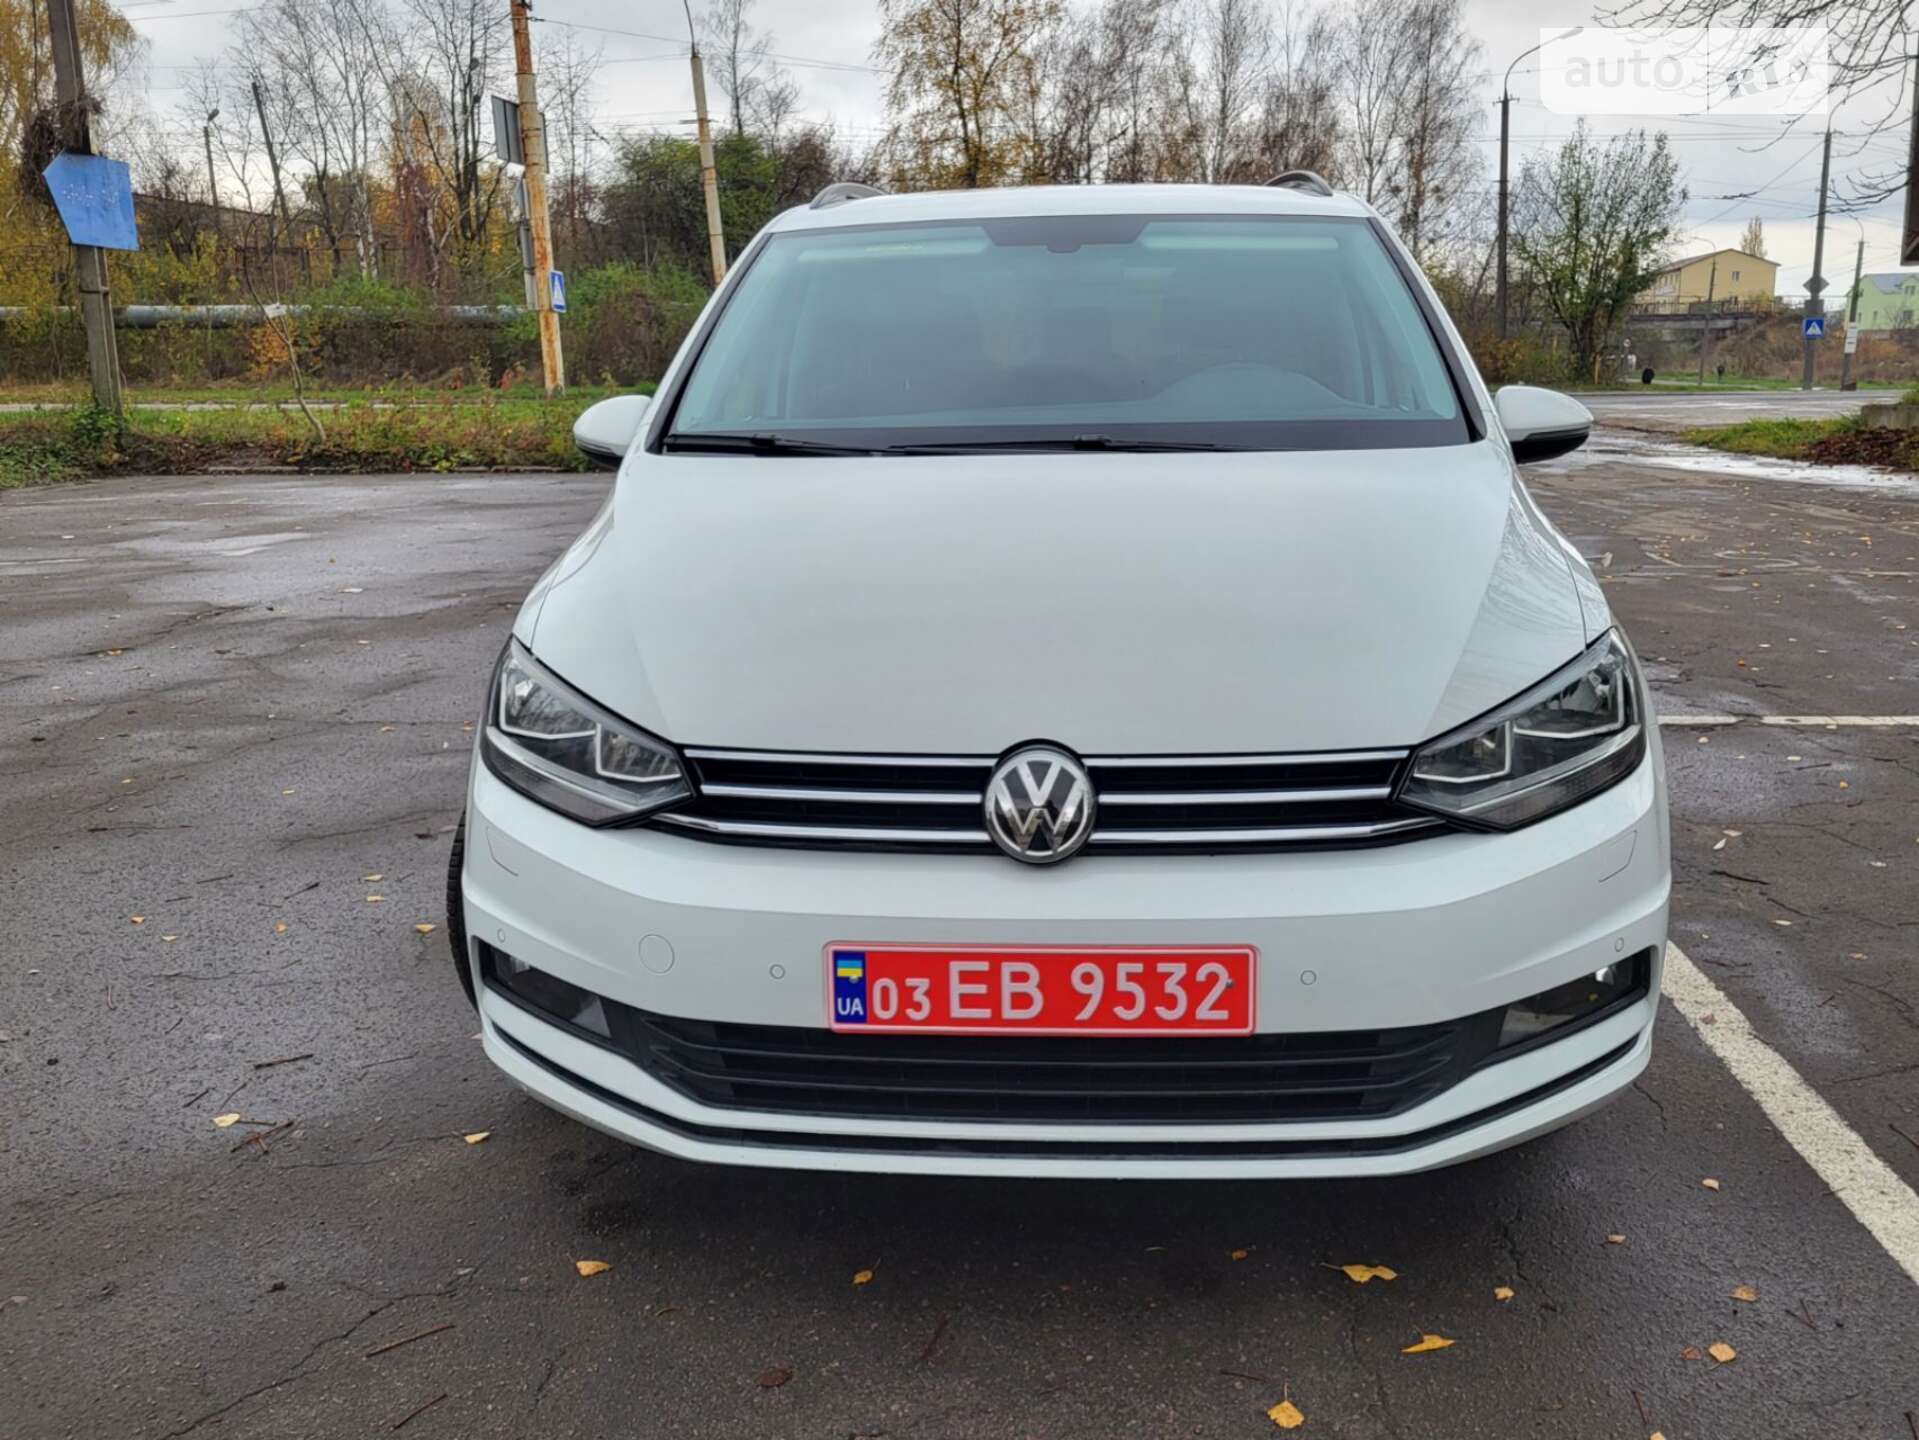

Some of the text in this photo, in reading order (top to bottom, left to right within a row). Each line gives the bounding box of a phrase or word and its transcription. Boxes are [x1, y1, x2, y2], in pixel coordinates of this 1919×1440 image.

[837, 997, 864, 1016] UA
[872, 961, 1231, 1021] 03 EB 9532
